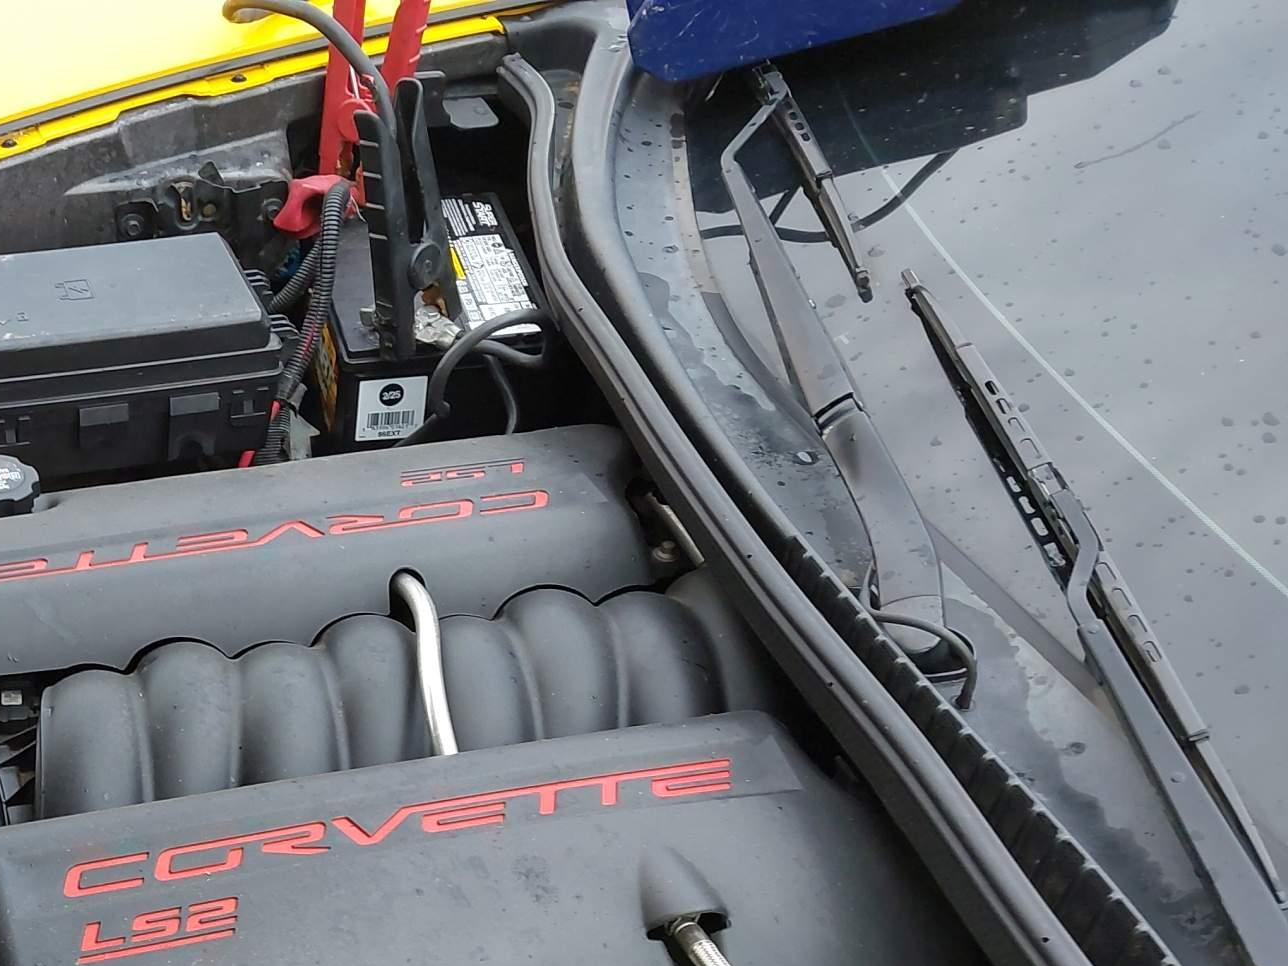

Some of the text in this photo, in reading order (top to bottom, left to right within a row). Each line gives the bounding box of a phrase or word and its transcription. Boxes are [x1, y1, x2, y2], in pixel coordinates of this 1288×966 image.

[400, 458, 525, 488] LS2
[63, 758, 731, 898] CORVETTE
[79, 897, 239, 958] LS2
